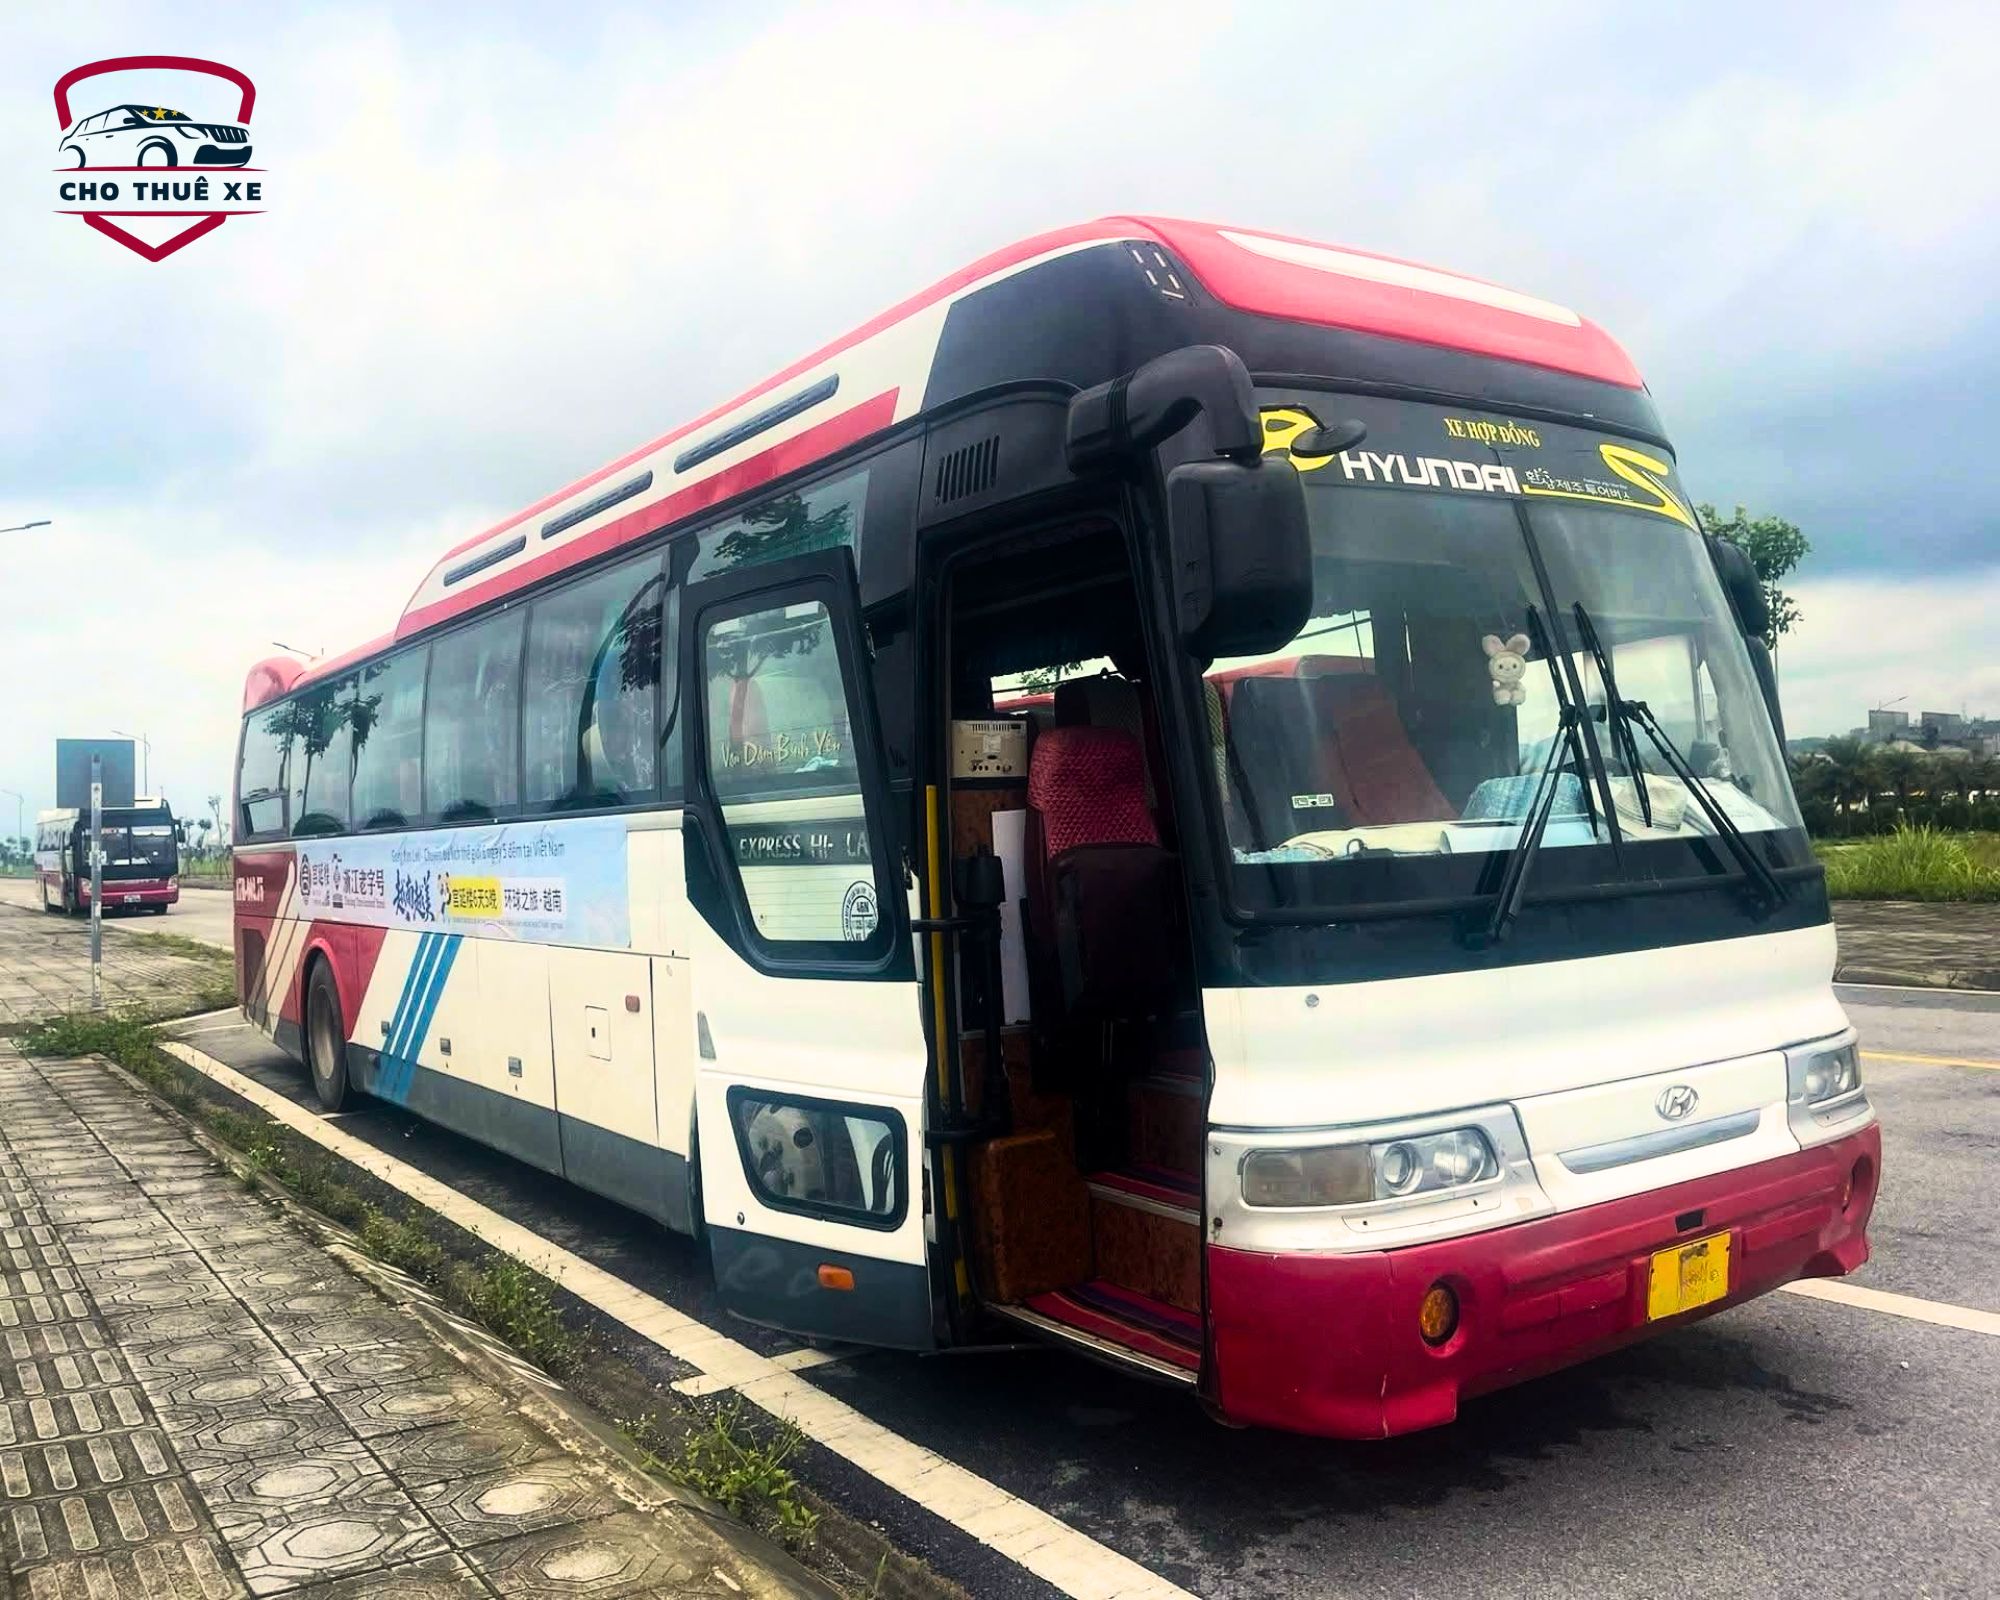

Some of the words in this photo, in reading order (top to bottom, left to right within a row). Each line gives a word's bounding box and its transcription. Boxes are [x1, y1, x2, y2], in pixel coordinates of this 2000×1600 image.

[1444, 418, 1466, 438] XE
[1466, 421, 1497, 445] HỢP
[1339, 451, 1522, 495] HYUNDAI
[740, 833, 801, 859] EXPRESS
